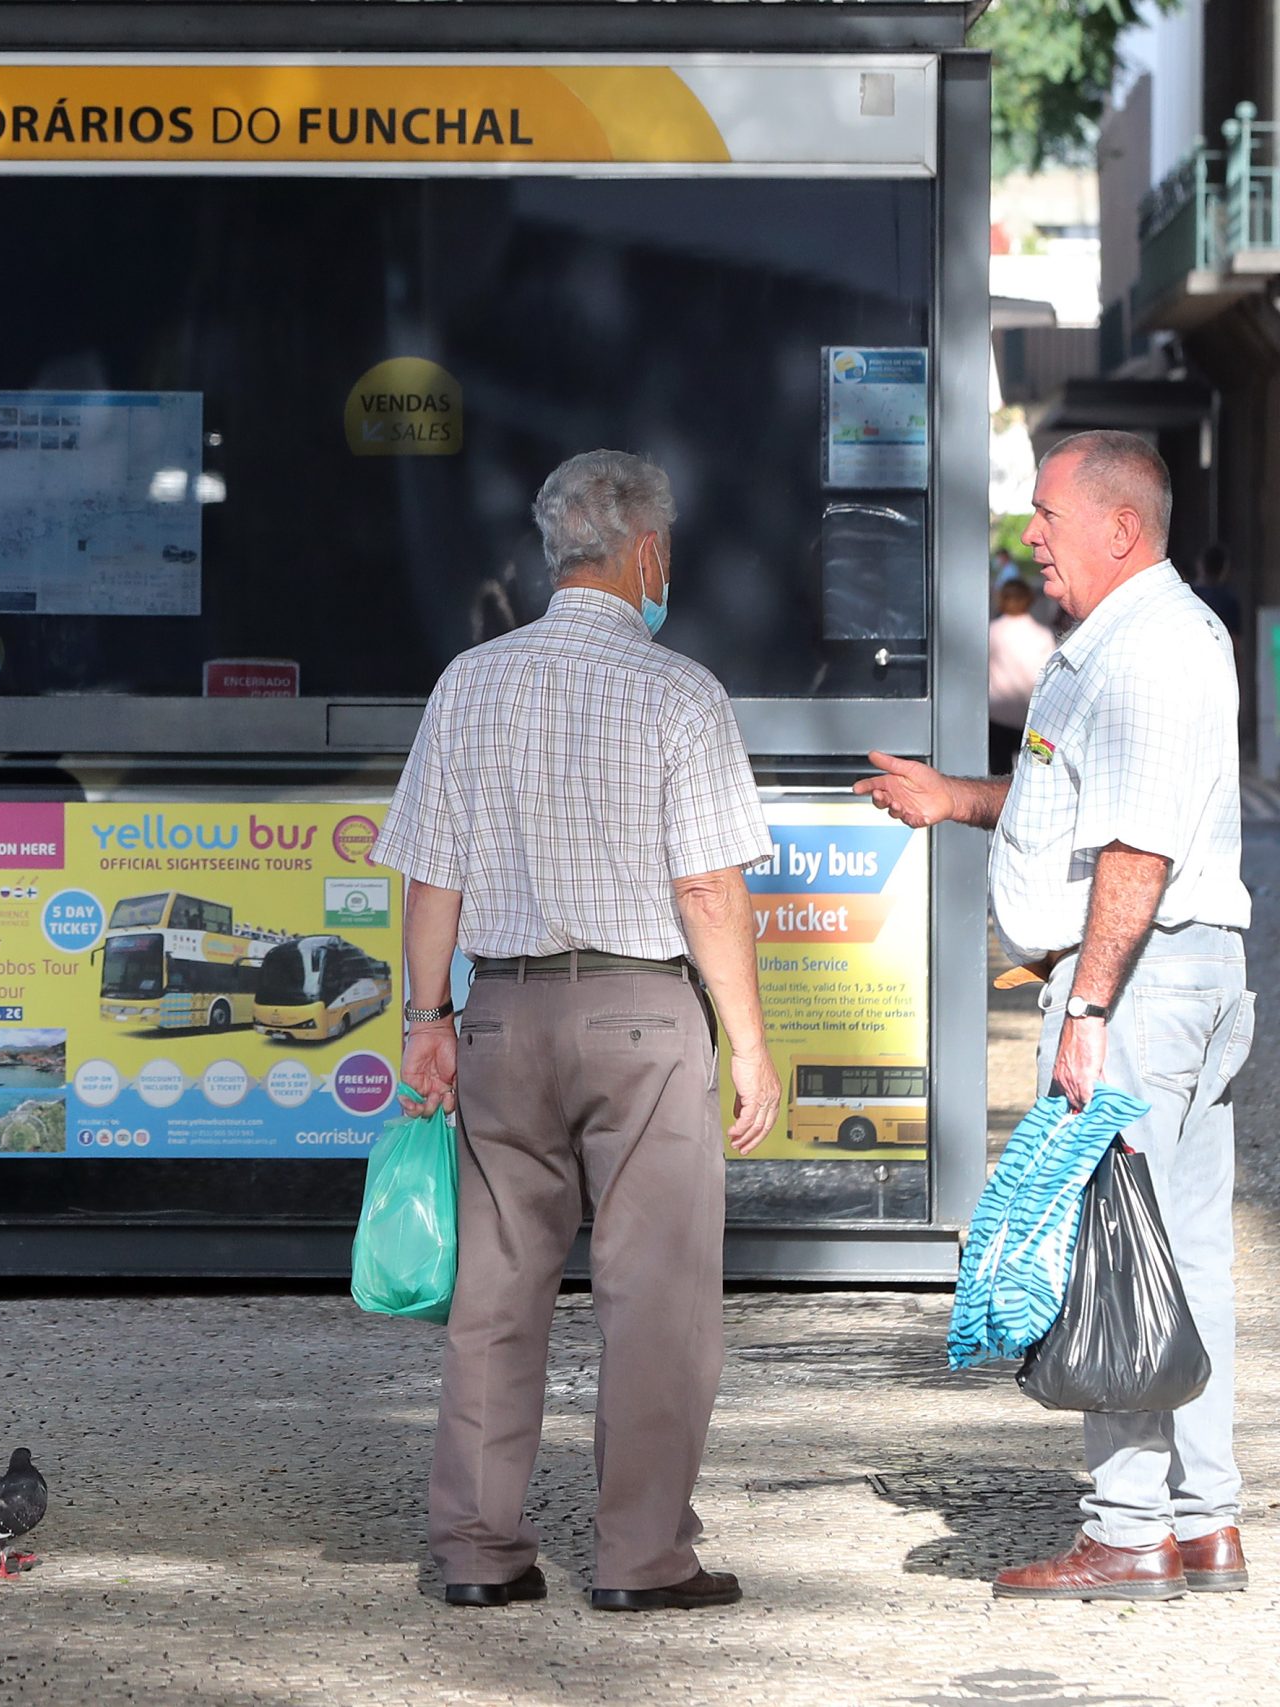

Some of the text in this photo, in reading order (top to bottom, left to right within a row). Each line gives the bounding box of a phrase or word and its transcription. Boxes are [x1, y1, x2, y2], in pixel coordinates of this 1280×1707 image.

[213, 107, 281, 144] DO
[298, 107, 533, 145] FUNCHAL
[361, 393, 450, 413] VENDAS
[391, 422, 451, 441] SALES
[223, 676, 290, 687] ENCERRADO
[92, 814, 239, 849] yellow
[249, 814, 317, 849] bus
[21, 843, 56, 856] HERE
[100, 857, 313, 870] OFFICIAL SIGHTSEEING TOURS
[789, 843, 822, 885] by
[828, 843, 878, 877] bus
[52, 906, 94, 918] 5 DAY
[755, 902, 849, 939] y ticket
[49, 922, 98, 936] TICKET
[42, 959, 79, 975] Tour
[759, 956, 848, 972] Urban Service
[789, 983, 809, 995] title,
[813, 983, 836, 992] valid
[837, 983, 851, 992] for
[878, 984, 883, 992] 5
[900, 984, 906, 992] 7
[765, 996, 812, 1007] (counting
[814, 996, 837, 1005] from
[839, 996, 856, 1005] the
[858, 996, 880, 1005] time
[882, 996, 892, 1005] of
[5, 1008, 22, 1019] 2€
[764, 1008, 915, 1020] ation), in any route of the urban
[780, 1022, 820, 1031] without
[822, 1022, 846, 1031] limit
[848, 1022, 860, 1031] of
[338, 1075, 388, 1084] FREE WIFI
[295, 1128, 375, 1144] carristur
